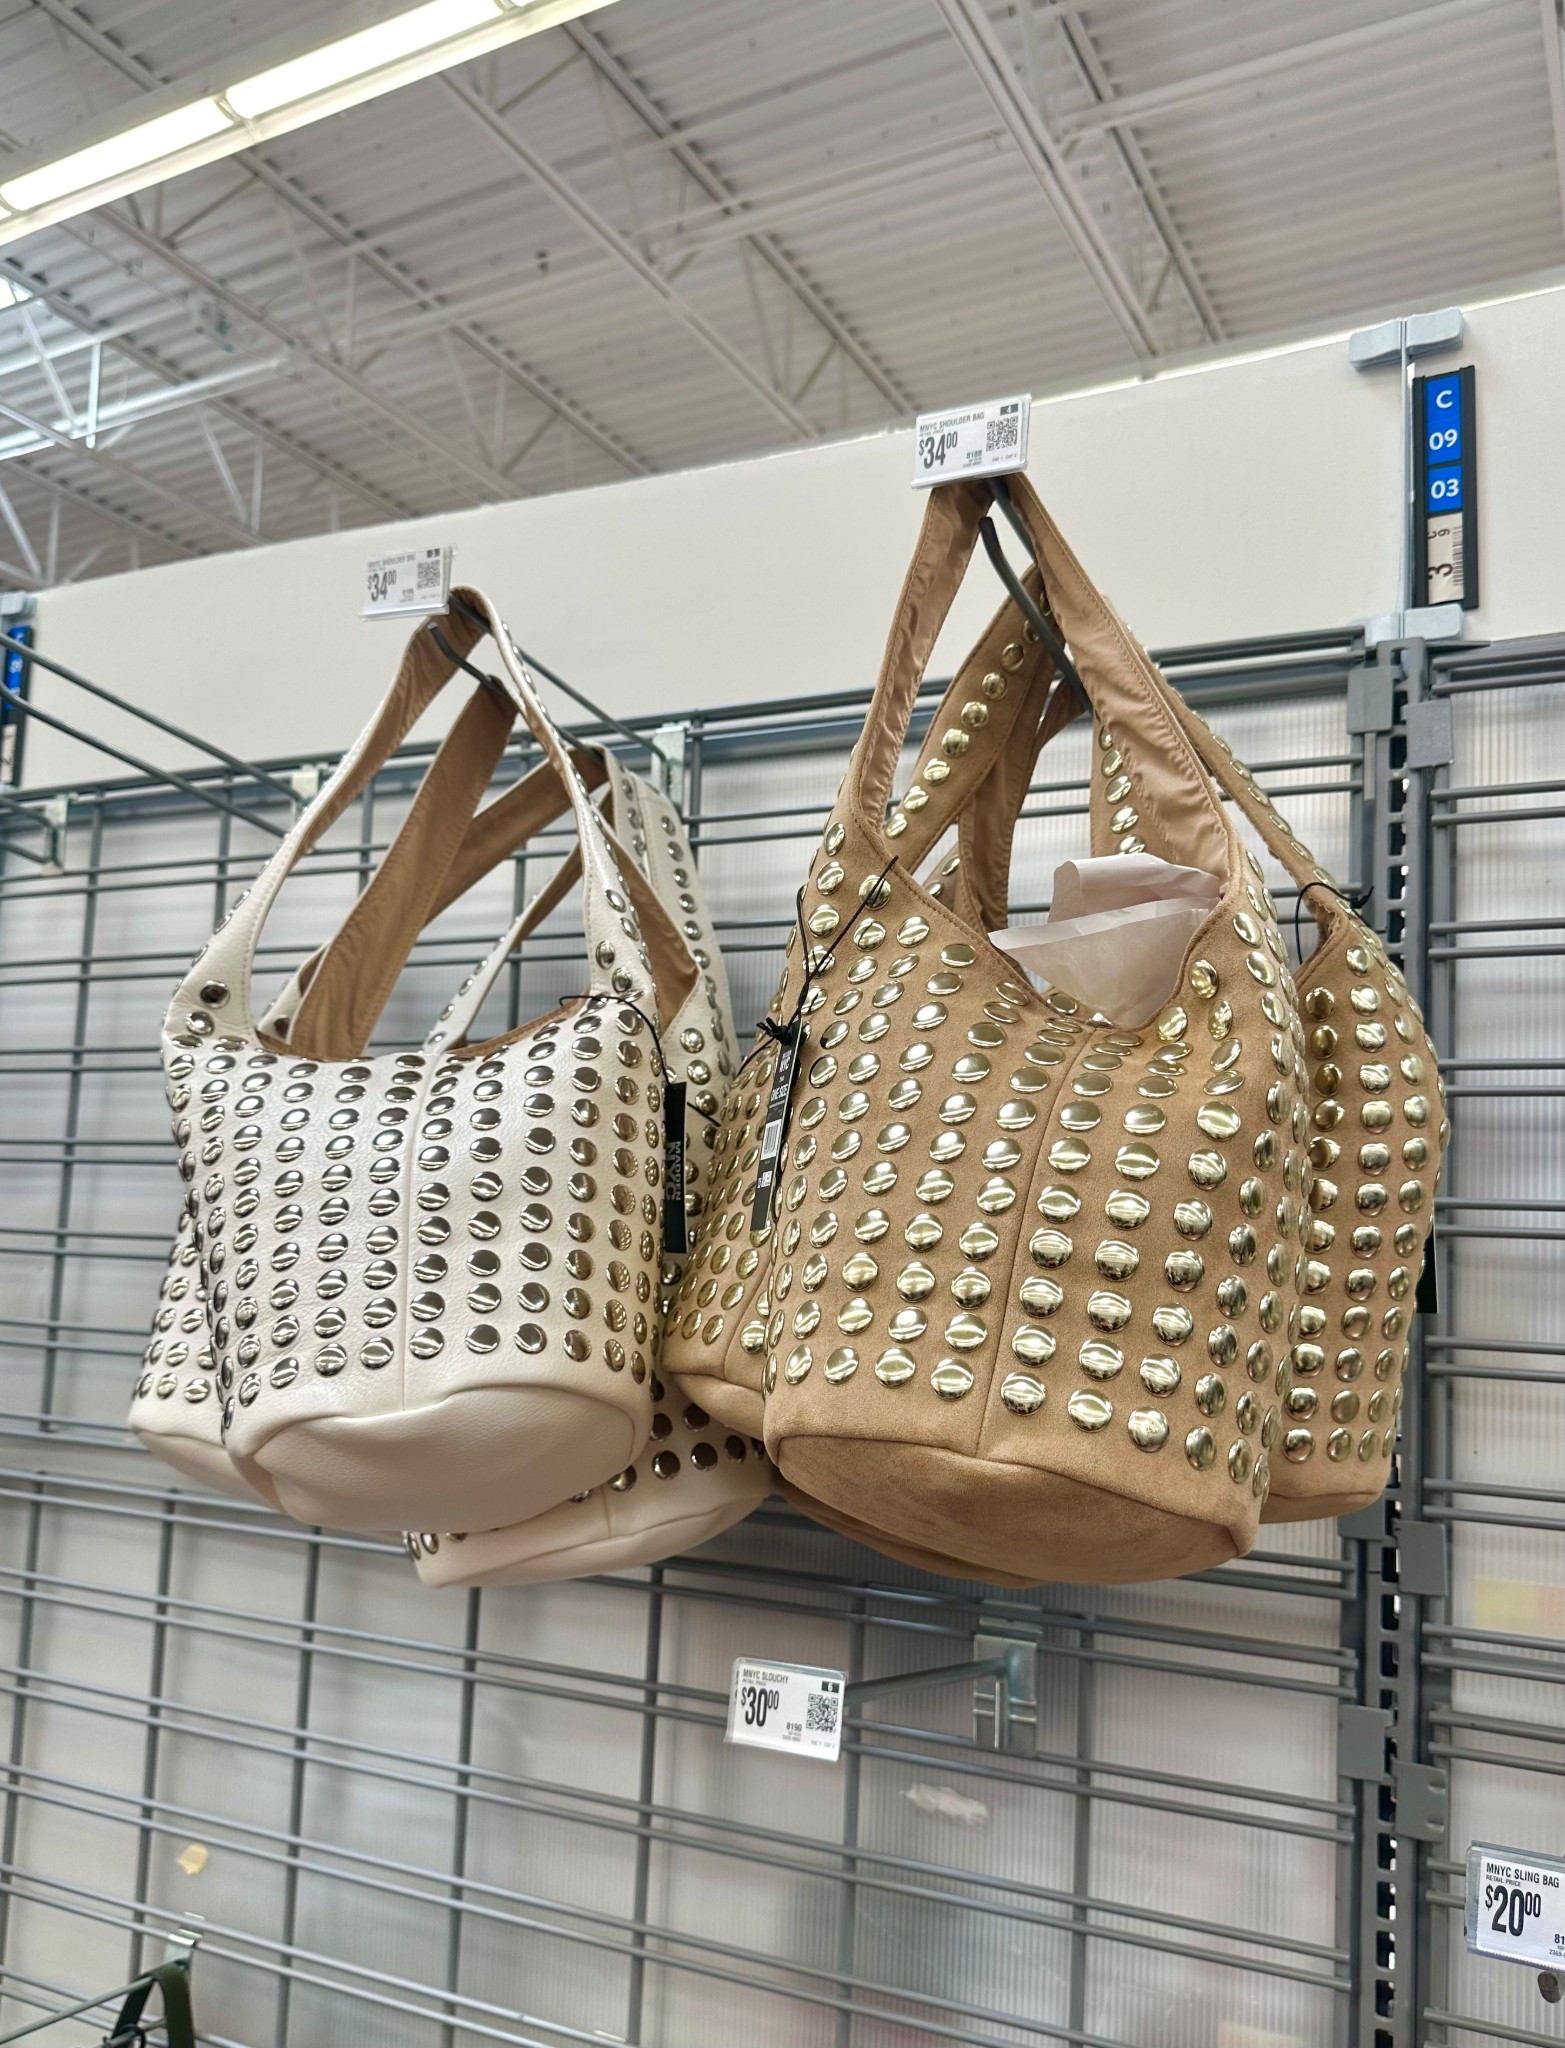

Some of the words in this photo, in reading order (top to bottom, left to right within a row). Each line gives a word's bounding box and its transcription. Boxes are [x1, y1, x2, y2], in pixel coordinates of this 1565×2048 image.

[1436, 390, 1453, 409] C
[939, 414, 971, 429] SHOULDER
[972, 411, 985, 422] BAG
[1429, 429, 1458, 451] 09
[1431, 478, 1460, 500] 03
[666, 1141, 676, 1201] NYC
[762, 1671, 789, 1684] SLOUCHY
[1486, 1862, 1511, 1878] MNYC
[1514, 1868, 1540, 1884] SLING
[1543, 1874, 1560, 1888] BAG
[1486, 1874, 1504, 1883] RETAIL
[1505, 1879, 1522, 1887] PRICE
